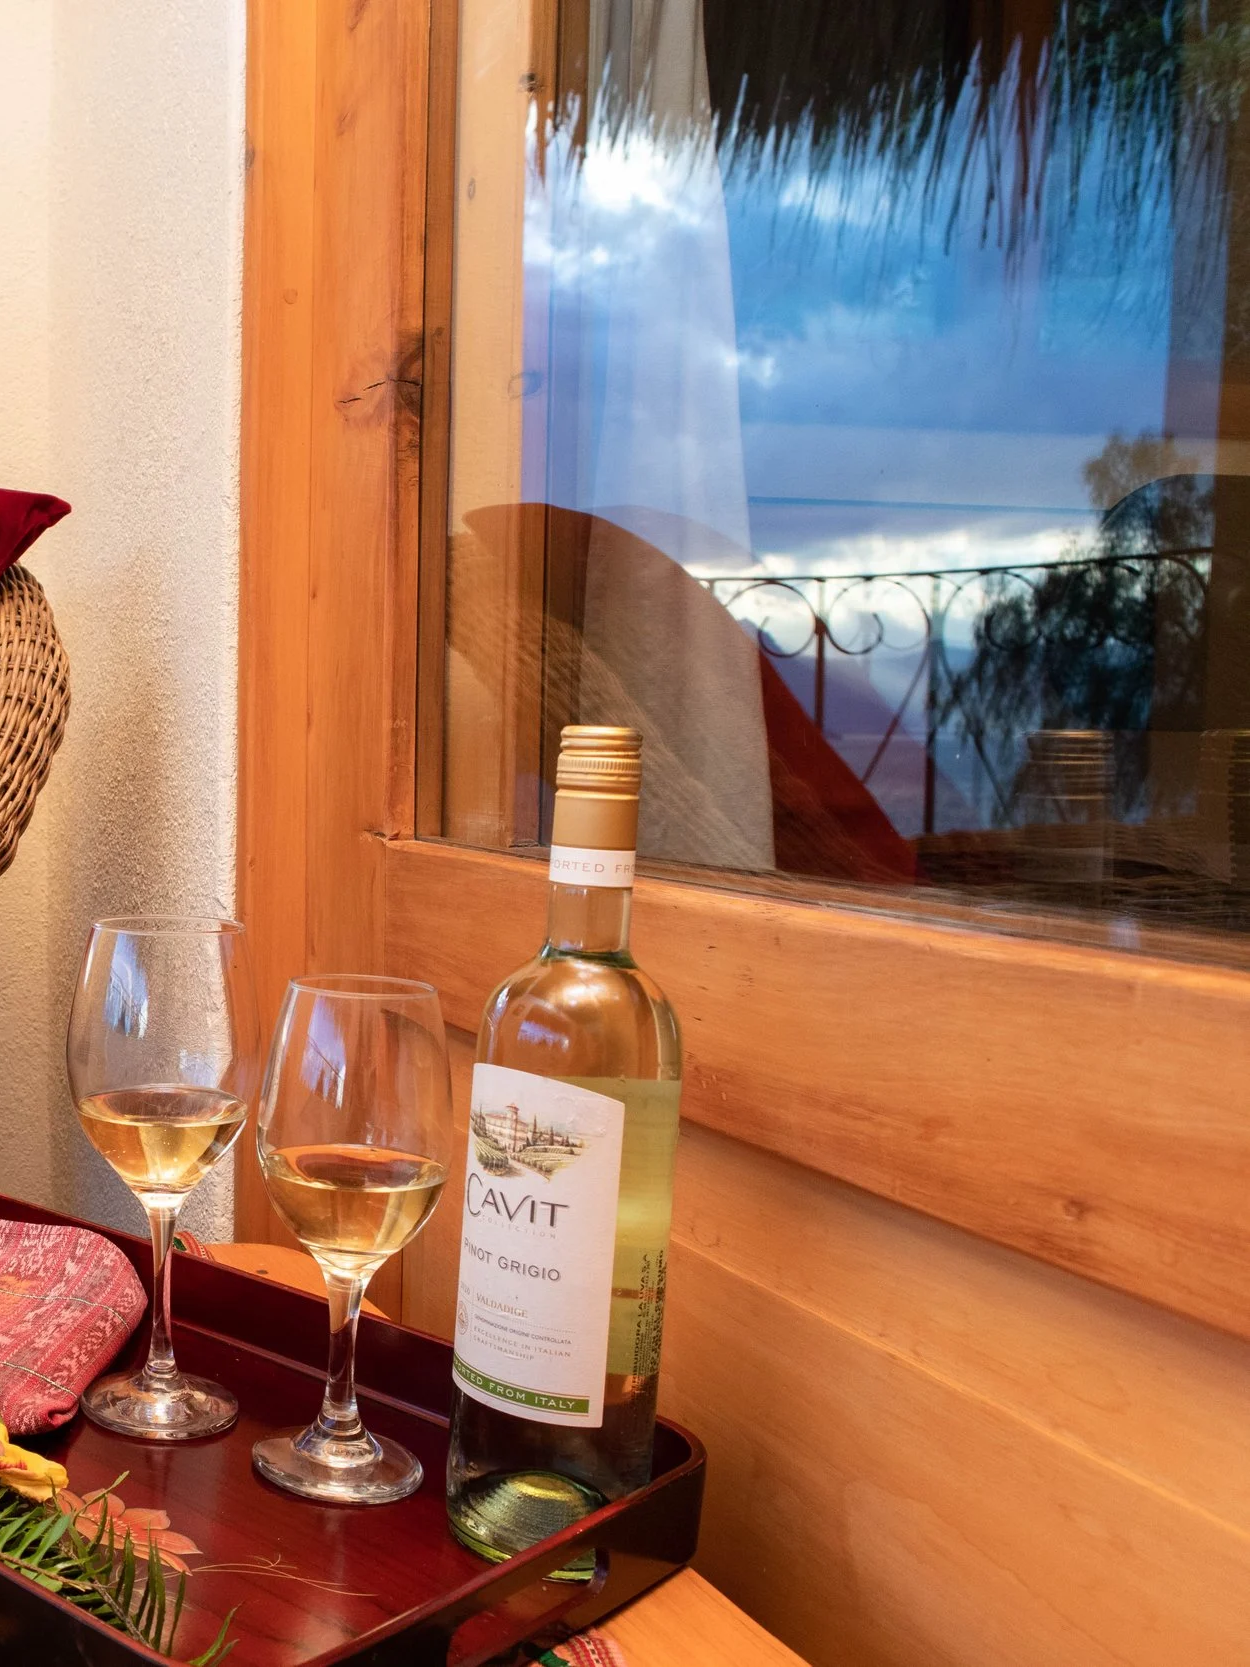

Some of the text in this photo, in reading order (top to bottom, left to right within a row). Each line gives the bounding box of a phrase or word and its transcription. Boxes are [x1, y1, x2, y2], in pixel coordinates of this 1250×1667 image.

[551, 859, 605, 873] ORTED
[467, 1172, 570, 1227] CAVIT
[464, 1237, 560, 1281] PINOT GRIGIO
[476, 1292, 528, 1318] VALDADIGE
[473, 1325, 571, 1358] EXCELLENCE IN ITALIAN
[531, 1333, 572, 1345] CONTROLLATA
[489, 1382, 526, 1401] FROM
[534, 1396, 575, 1410] ITALY
